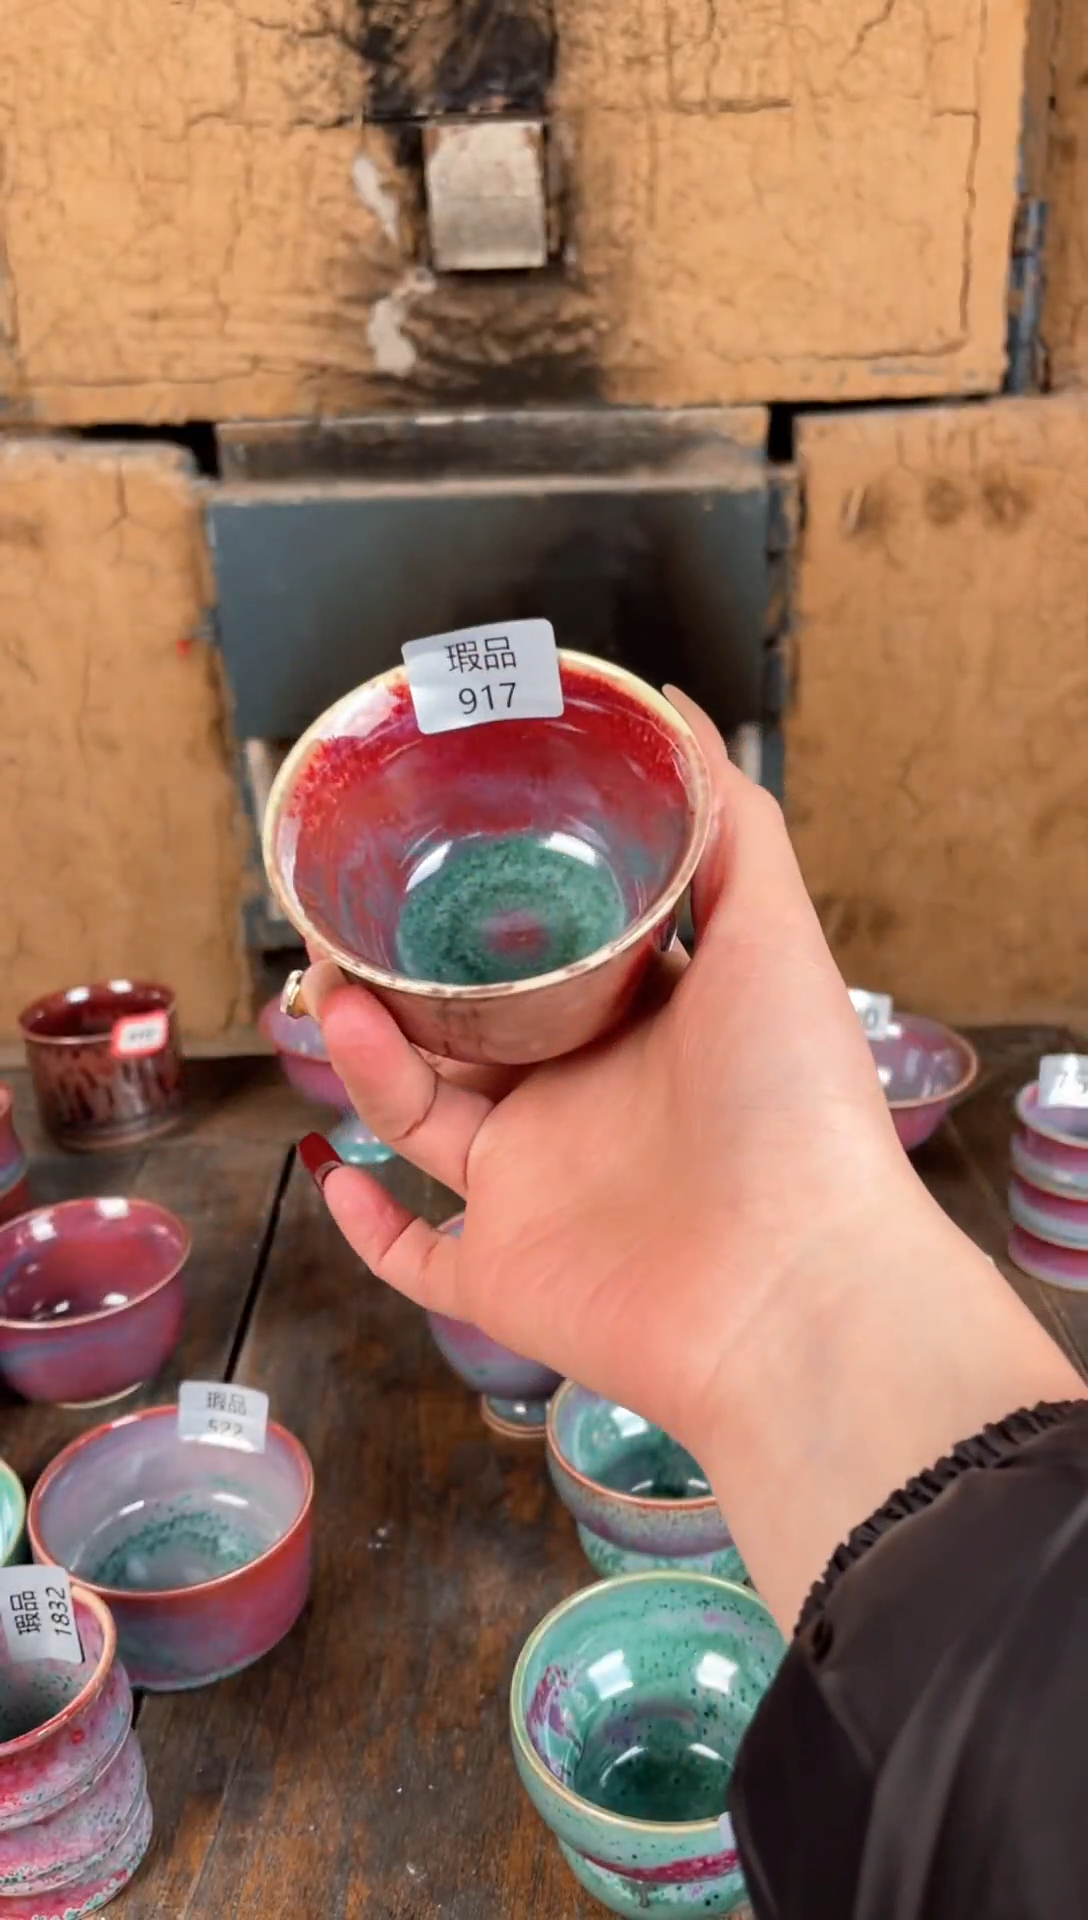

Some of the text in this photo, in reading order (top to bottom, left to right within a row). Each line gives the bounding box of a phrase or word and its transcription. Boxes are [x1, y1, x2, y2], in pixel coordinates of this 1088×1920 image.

[444, 635, 517, 674] 瑕品
[458, 682, 516, 715] 917
[9, 1590, 41, 1636] 瑕品
[45, 1586, 72, 1636] 1832
